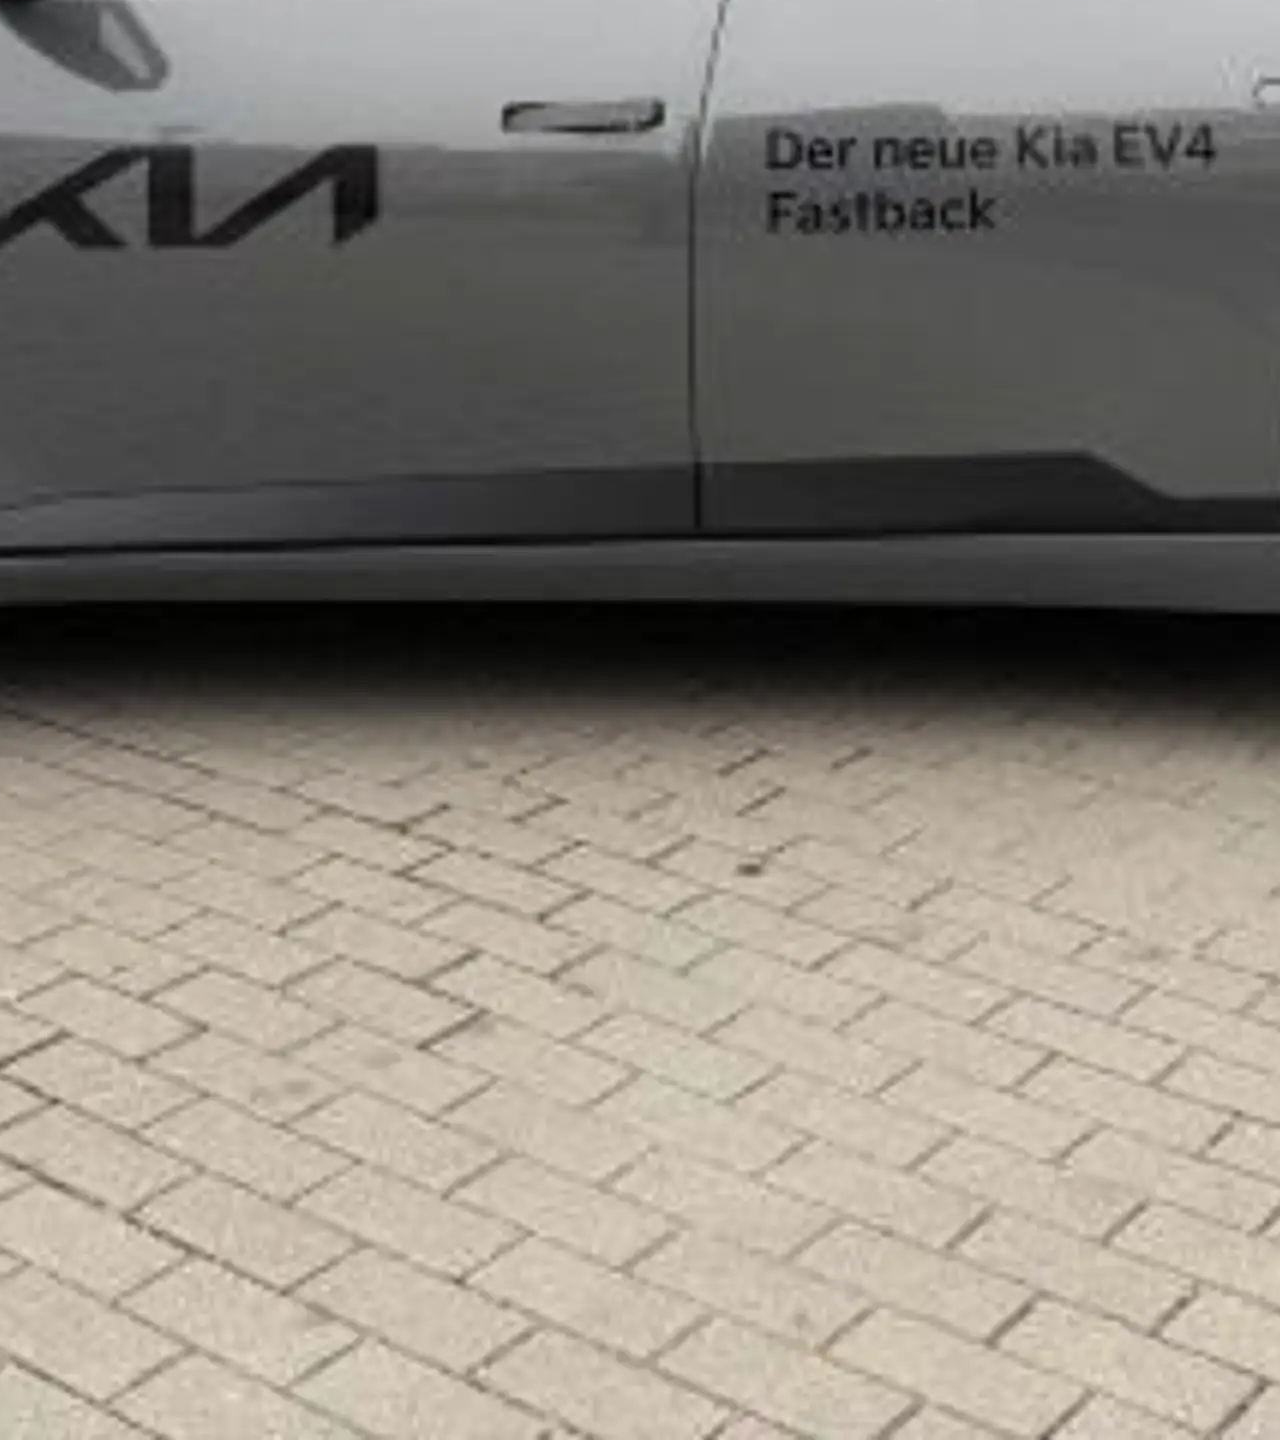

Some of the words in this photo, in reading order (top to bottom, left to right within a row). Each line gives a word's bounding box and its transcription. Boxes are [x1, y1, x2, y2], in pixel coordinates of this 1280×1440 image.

[764, 127, 858, 171] Der
[872, 135, 999, 171] neue
[1015, 124, 1099, 170] Kia
[1113, 123, 1217, 170] EV4
[765, 190, 997, 235] Fastback
